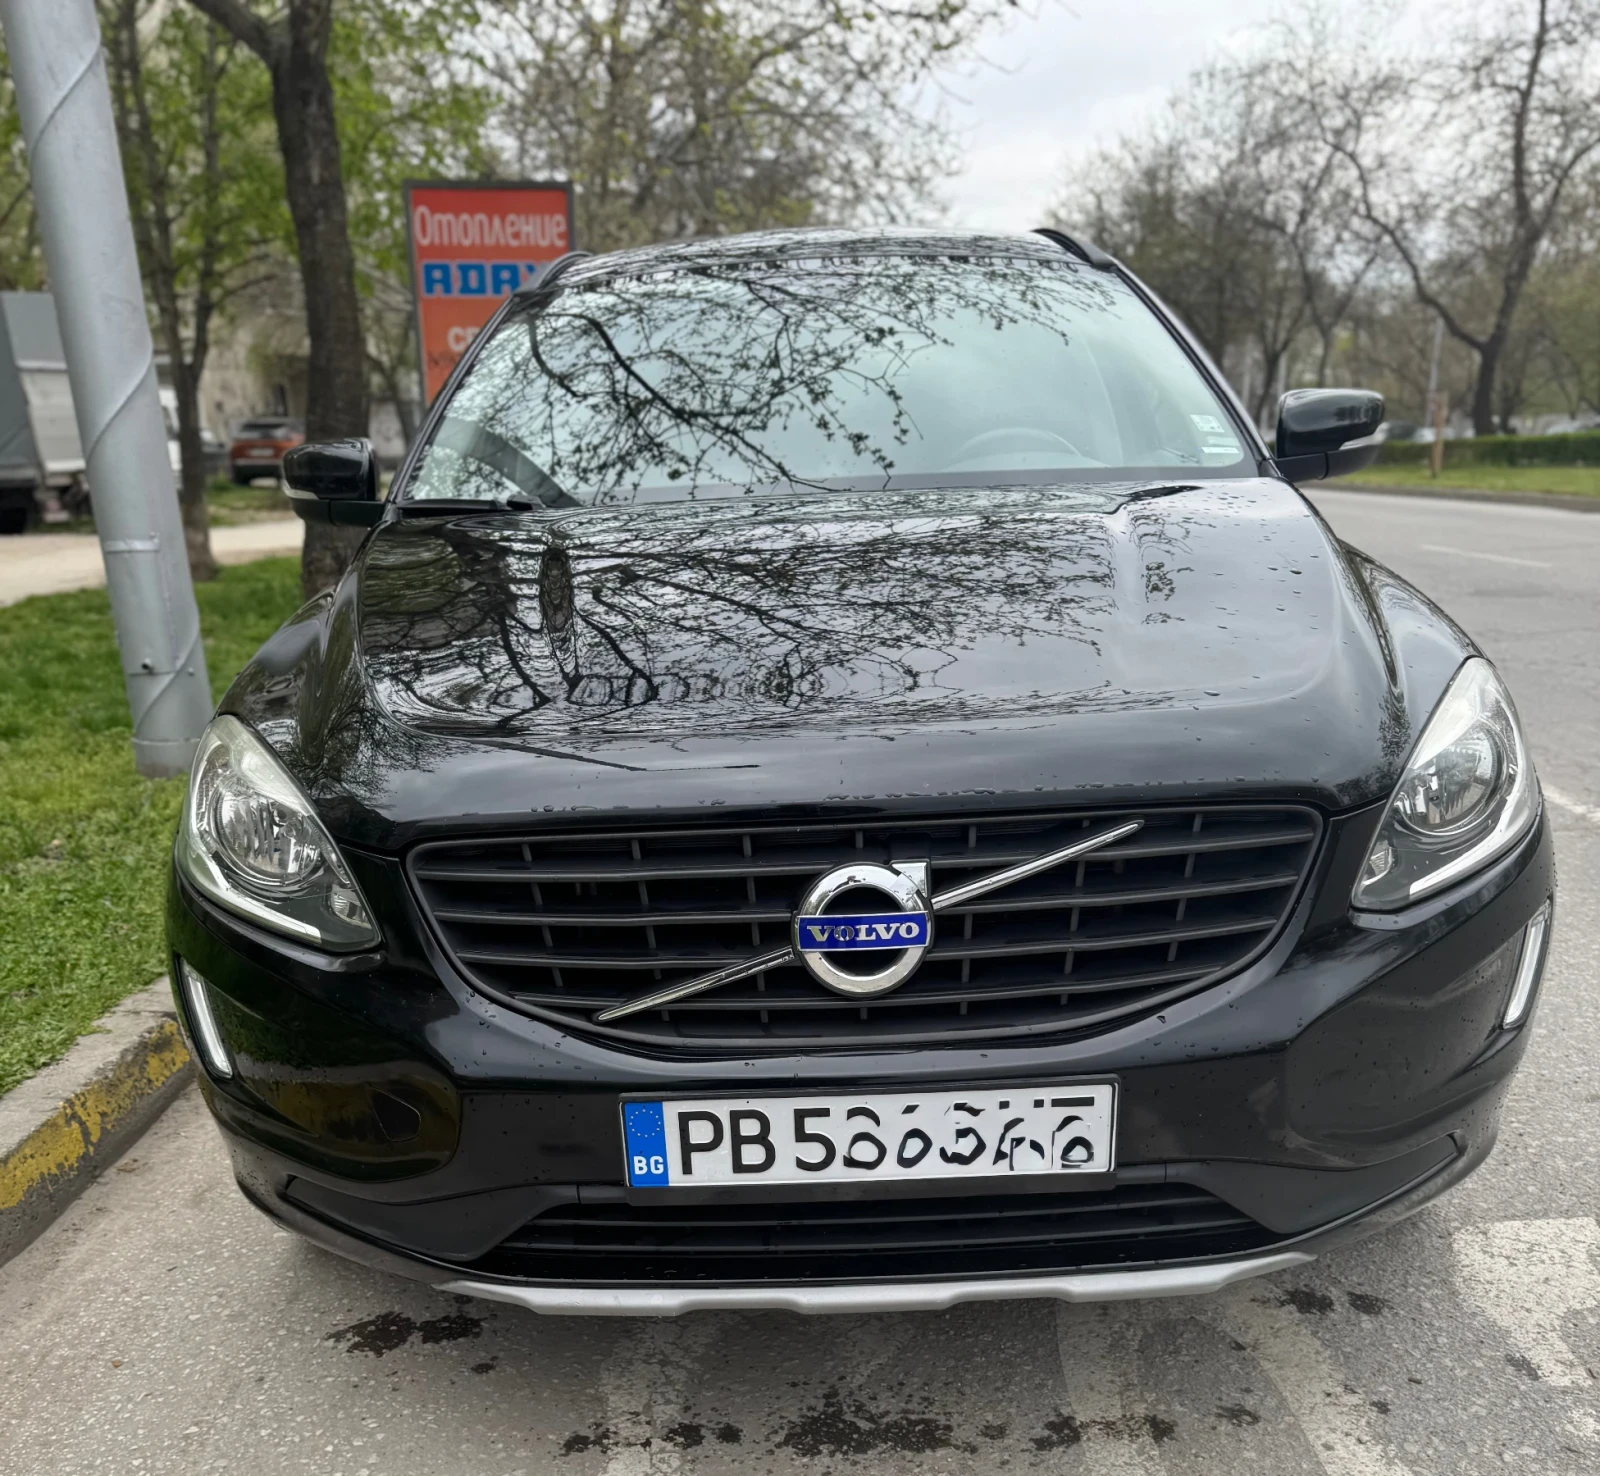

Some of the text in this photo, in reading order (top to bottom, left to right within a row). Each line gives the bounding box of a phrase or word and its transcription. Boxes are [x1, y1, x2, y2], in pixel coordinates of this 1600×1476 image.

[414, 205, 567, 247] Отопление
[422, 262, 536, 295] ADA
[806, 922, 920, 942] VOLVO
[633, 1155, 664, 1175] BG
